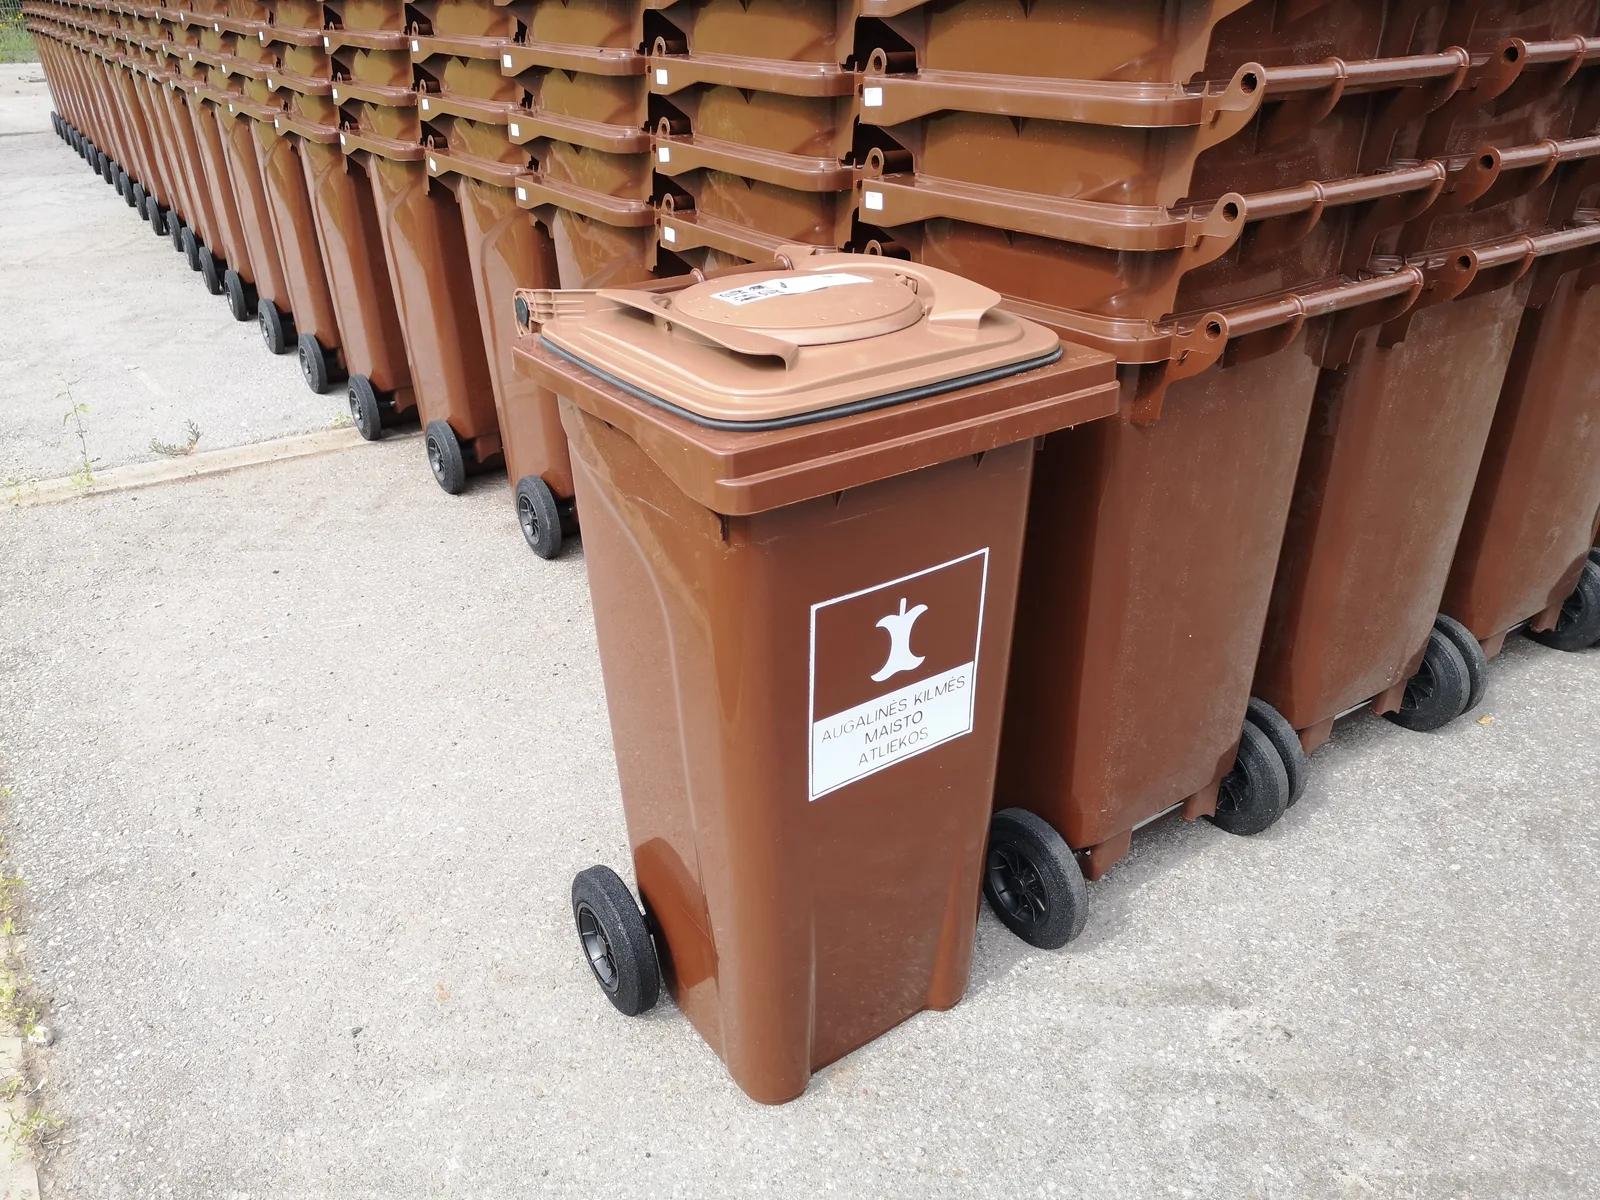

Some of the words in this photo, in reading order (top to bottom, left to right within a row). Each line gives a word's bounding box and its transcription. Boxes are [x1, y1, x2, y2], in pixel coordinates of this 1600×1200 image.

[821, 698, 908, 743] AUGALINĖS
[913, 675, 966, 706] KILMĖS
[864, 710, 924, 745] MAISTO
[858, 726, 929, 767] ATLIEKOS
